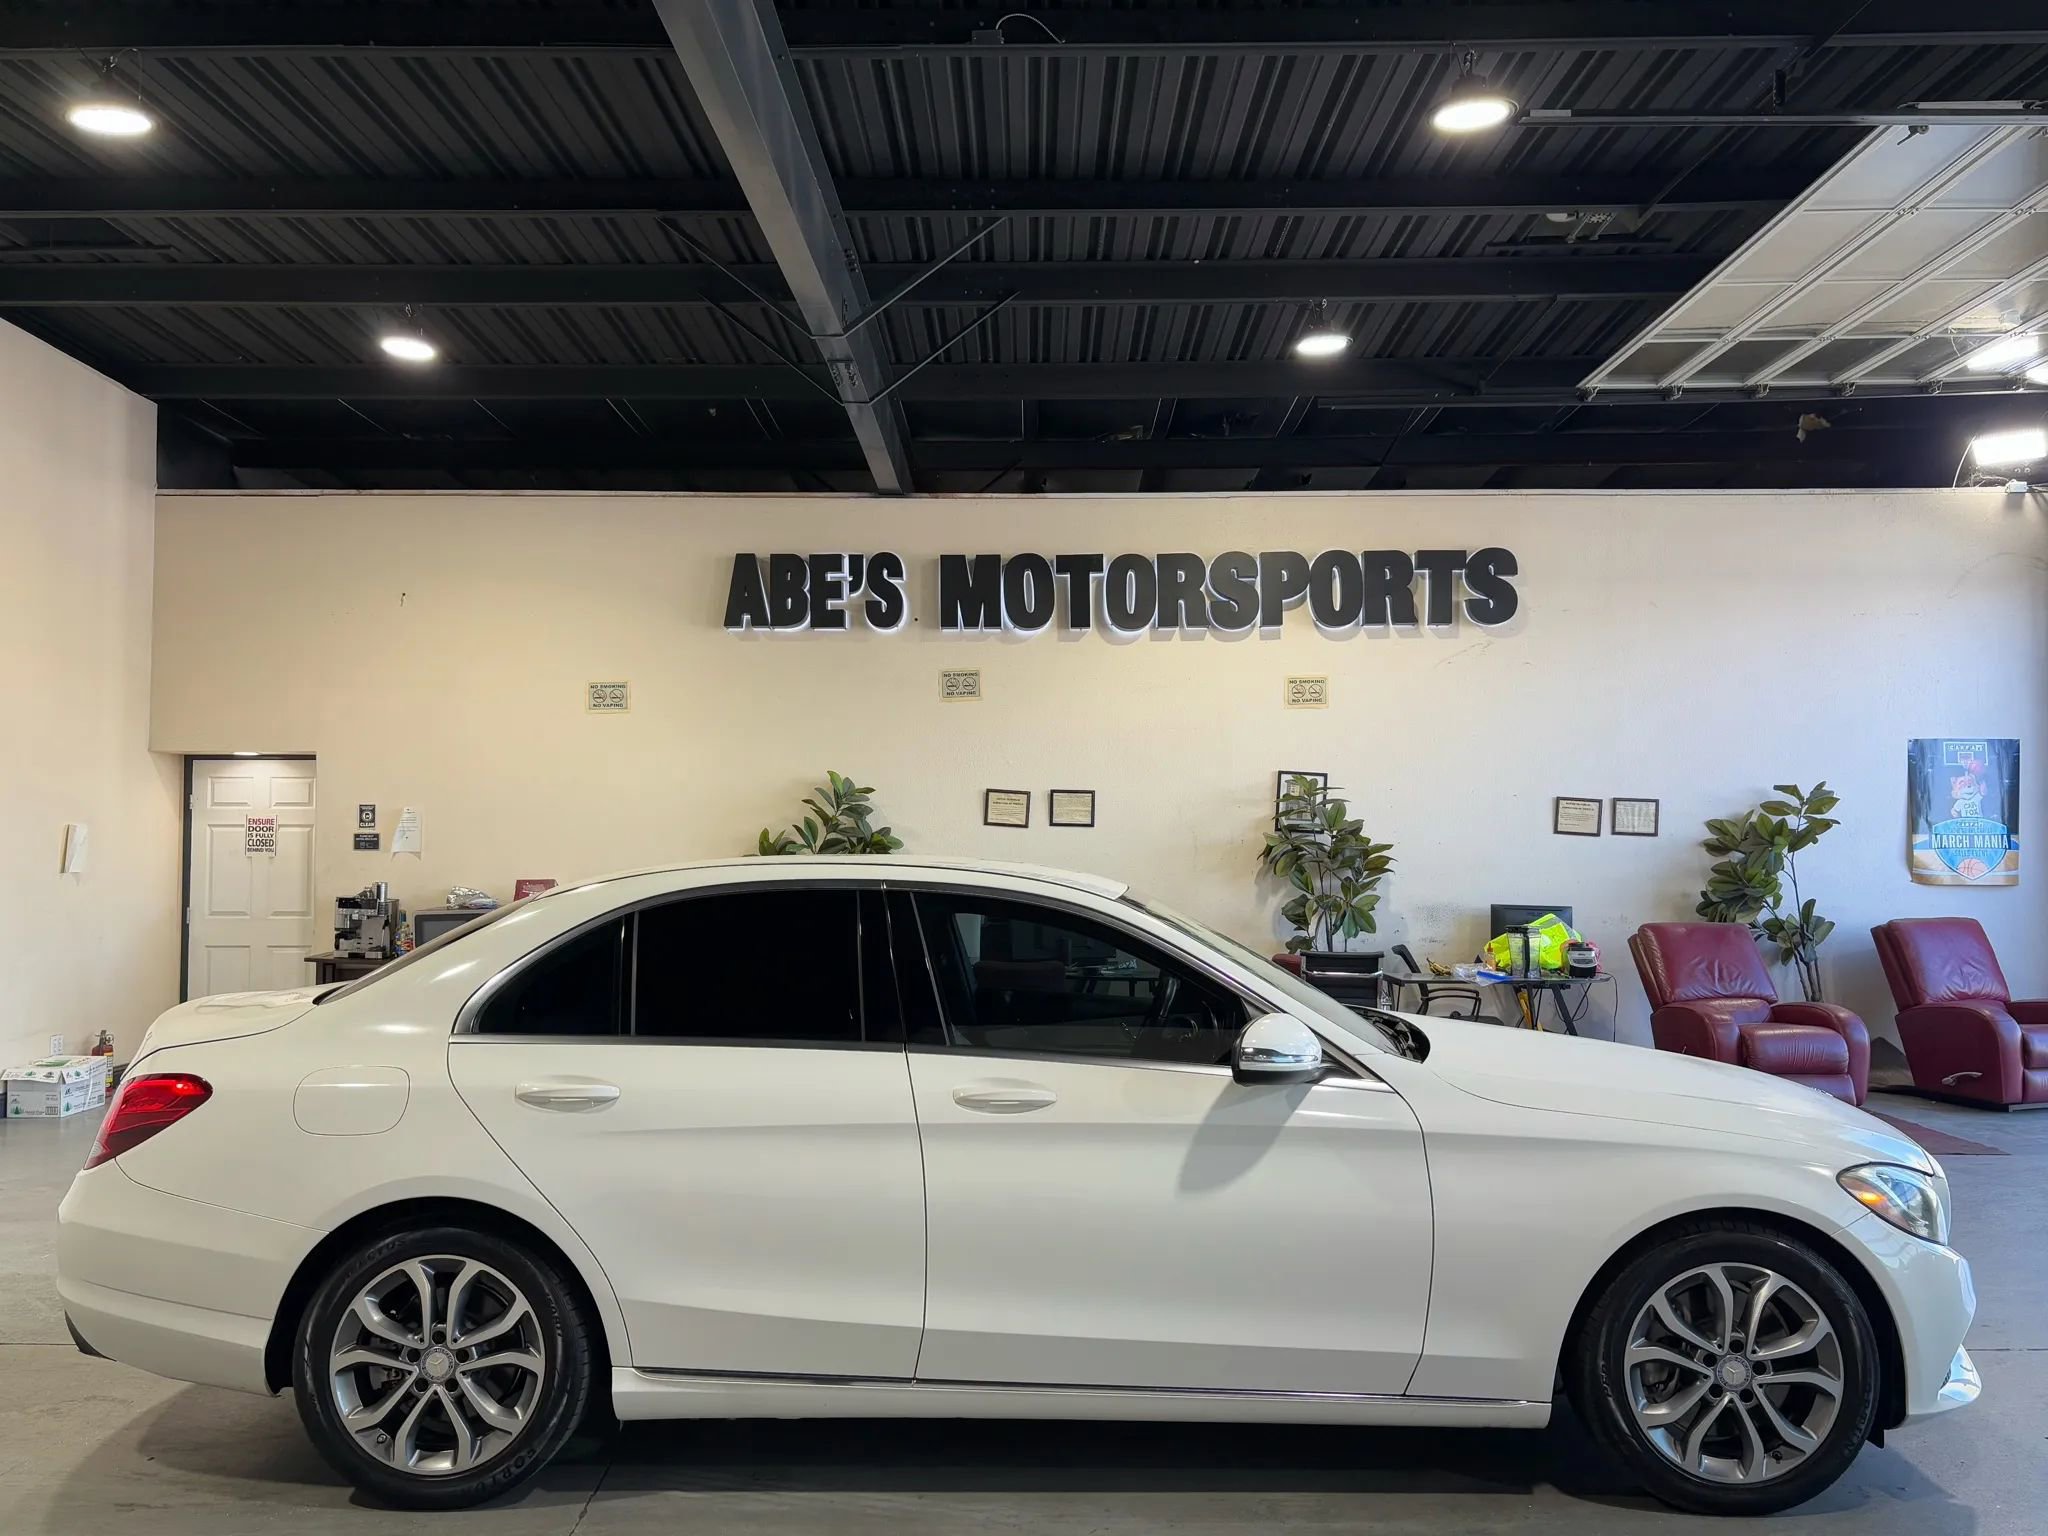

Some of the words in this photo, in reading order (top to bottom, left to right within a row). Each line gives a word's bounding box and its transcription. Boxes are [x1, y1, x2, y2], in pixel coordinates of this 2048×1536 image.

[724, 551, 905, 630] ABE'S
[939, 547, 1519, 631] MOTORSPORTS
[1965, 808, 1978, 816] FOX
[247, 838, 275, 847] CLOSED
[1931, 834, 1970, 849] MARCH
[1974, 834, 2009, 849] MANIA
